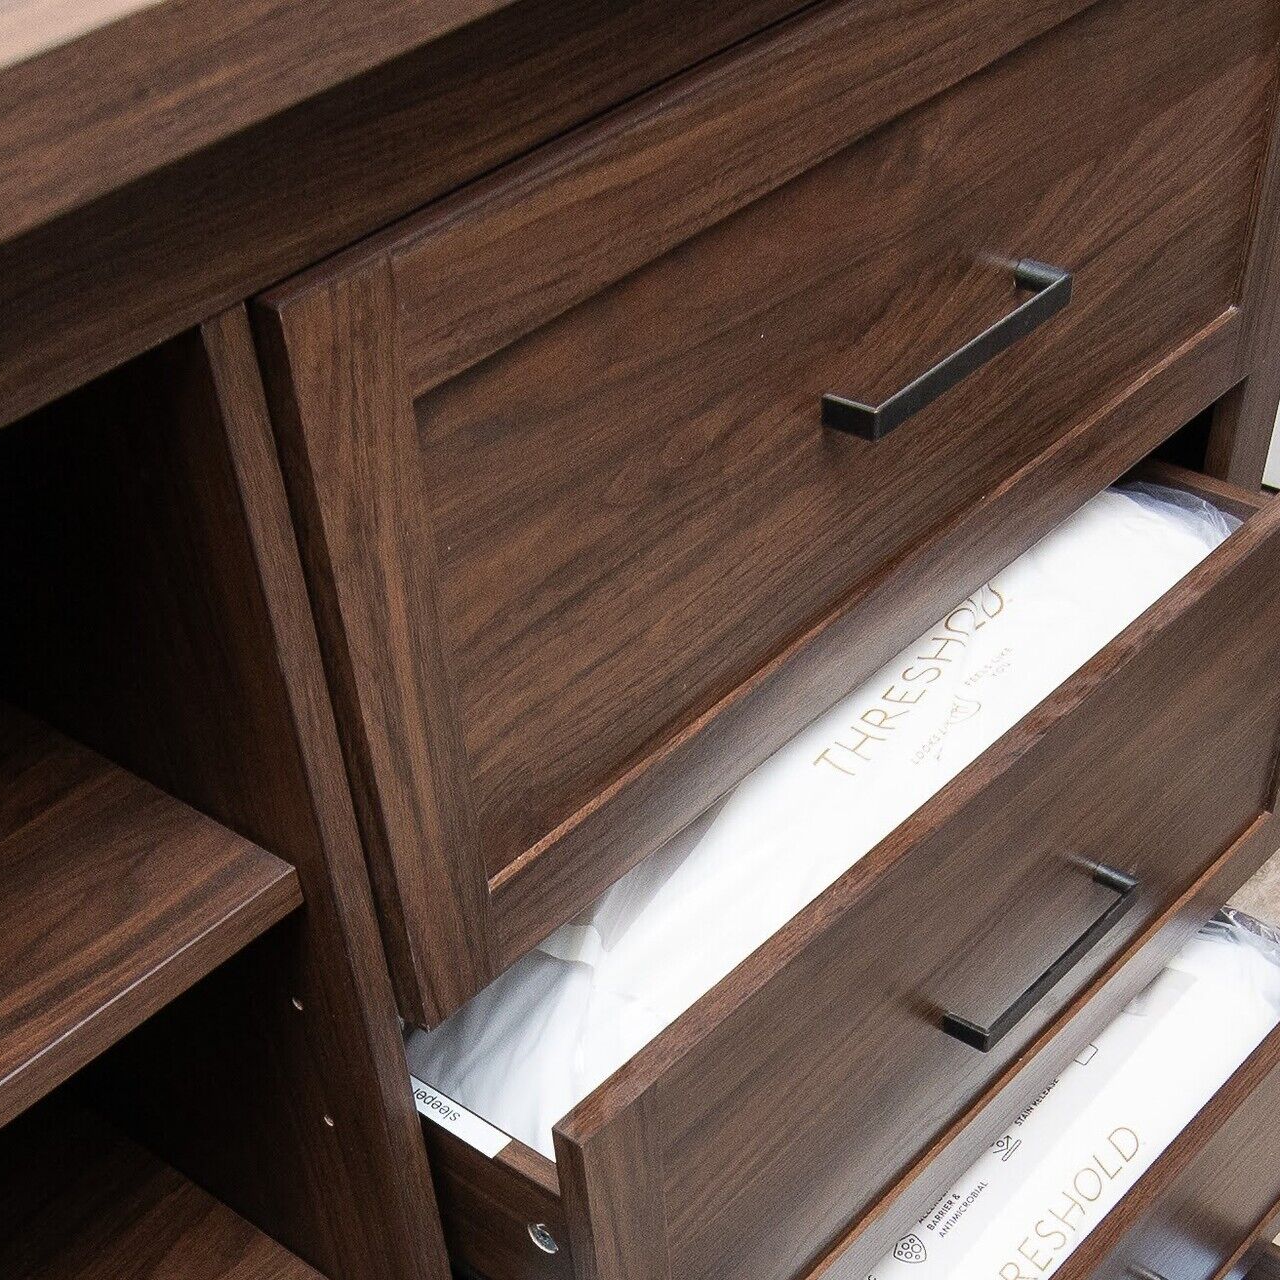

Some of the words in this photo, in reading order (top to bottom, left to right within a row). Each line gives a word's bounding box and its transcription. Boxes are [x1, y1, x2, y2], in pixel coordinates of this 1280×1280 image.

[1014, 1104, 1034, 1126] STAIN
[926, 1199, 956, 1231] BARRIER
[951, 1193, 961, 1201] &
[939, 1181, 989, 1238] ANTIMICROBIAL
